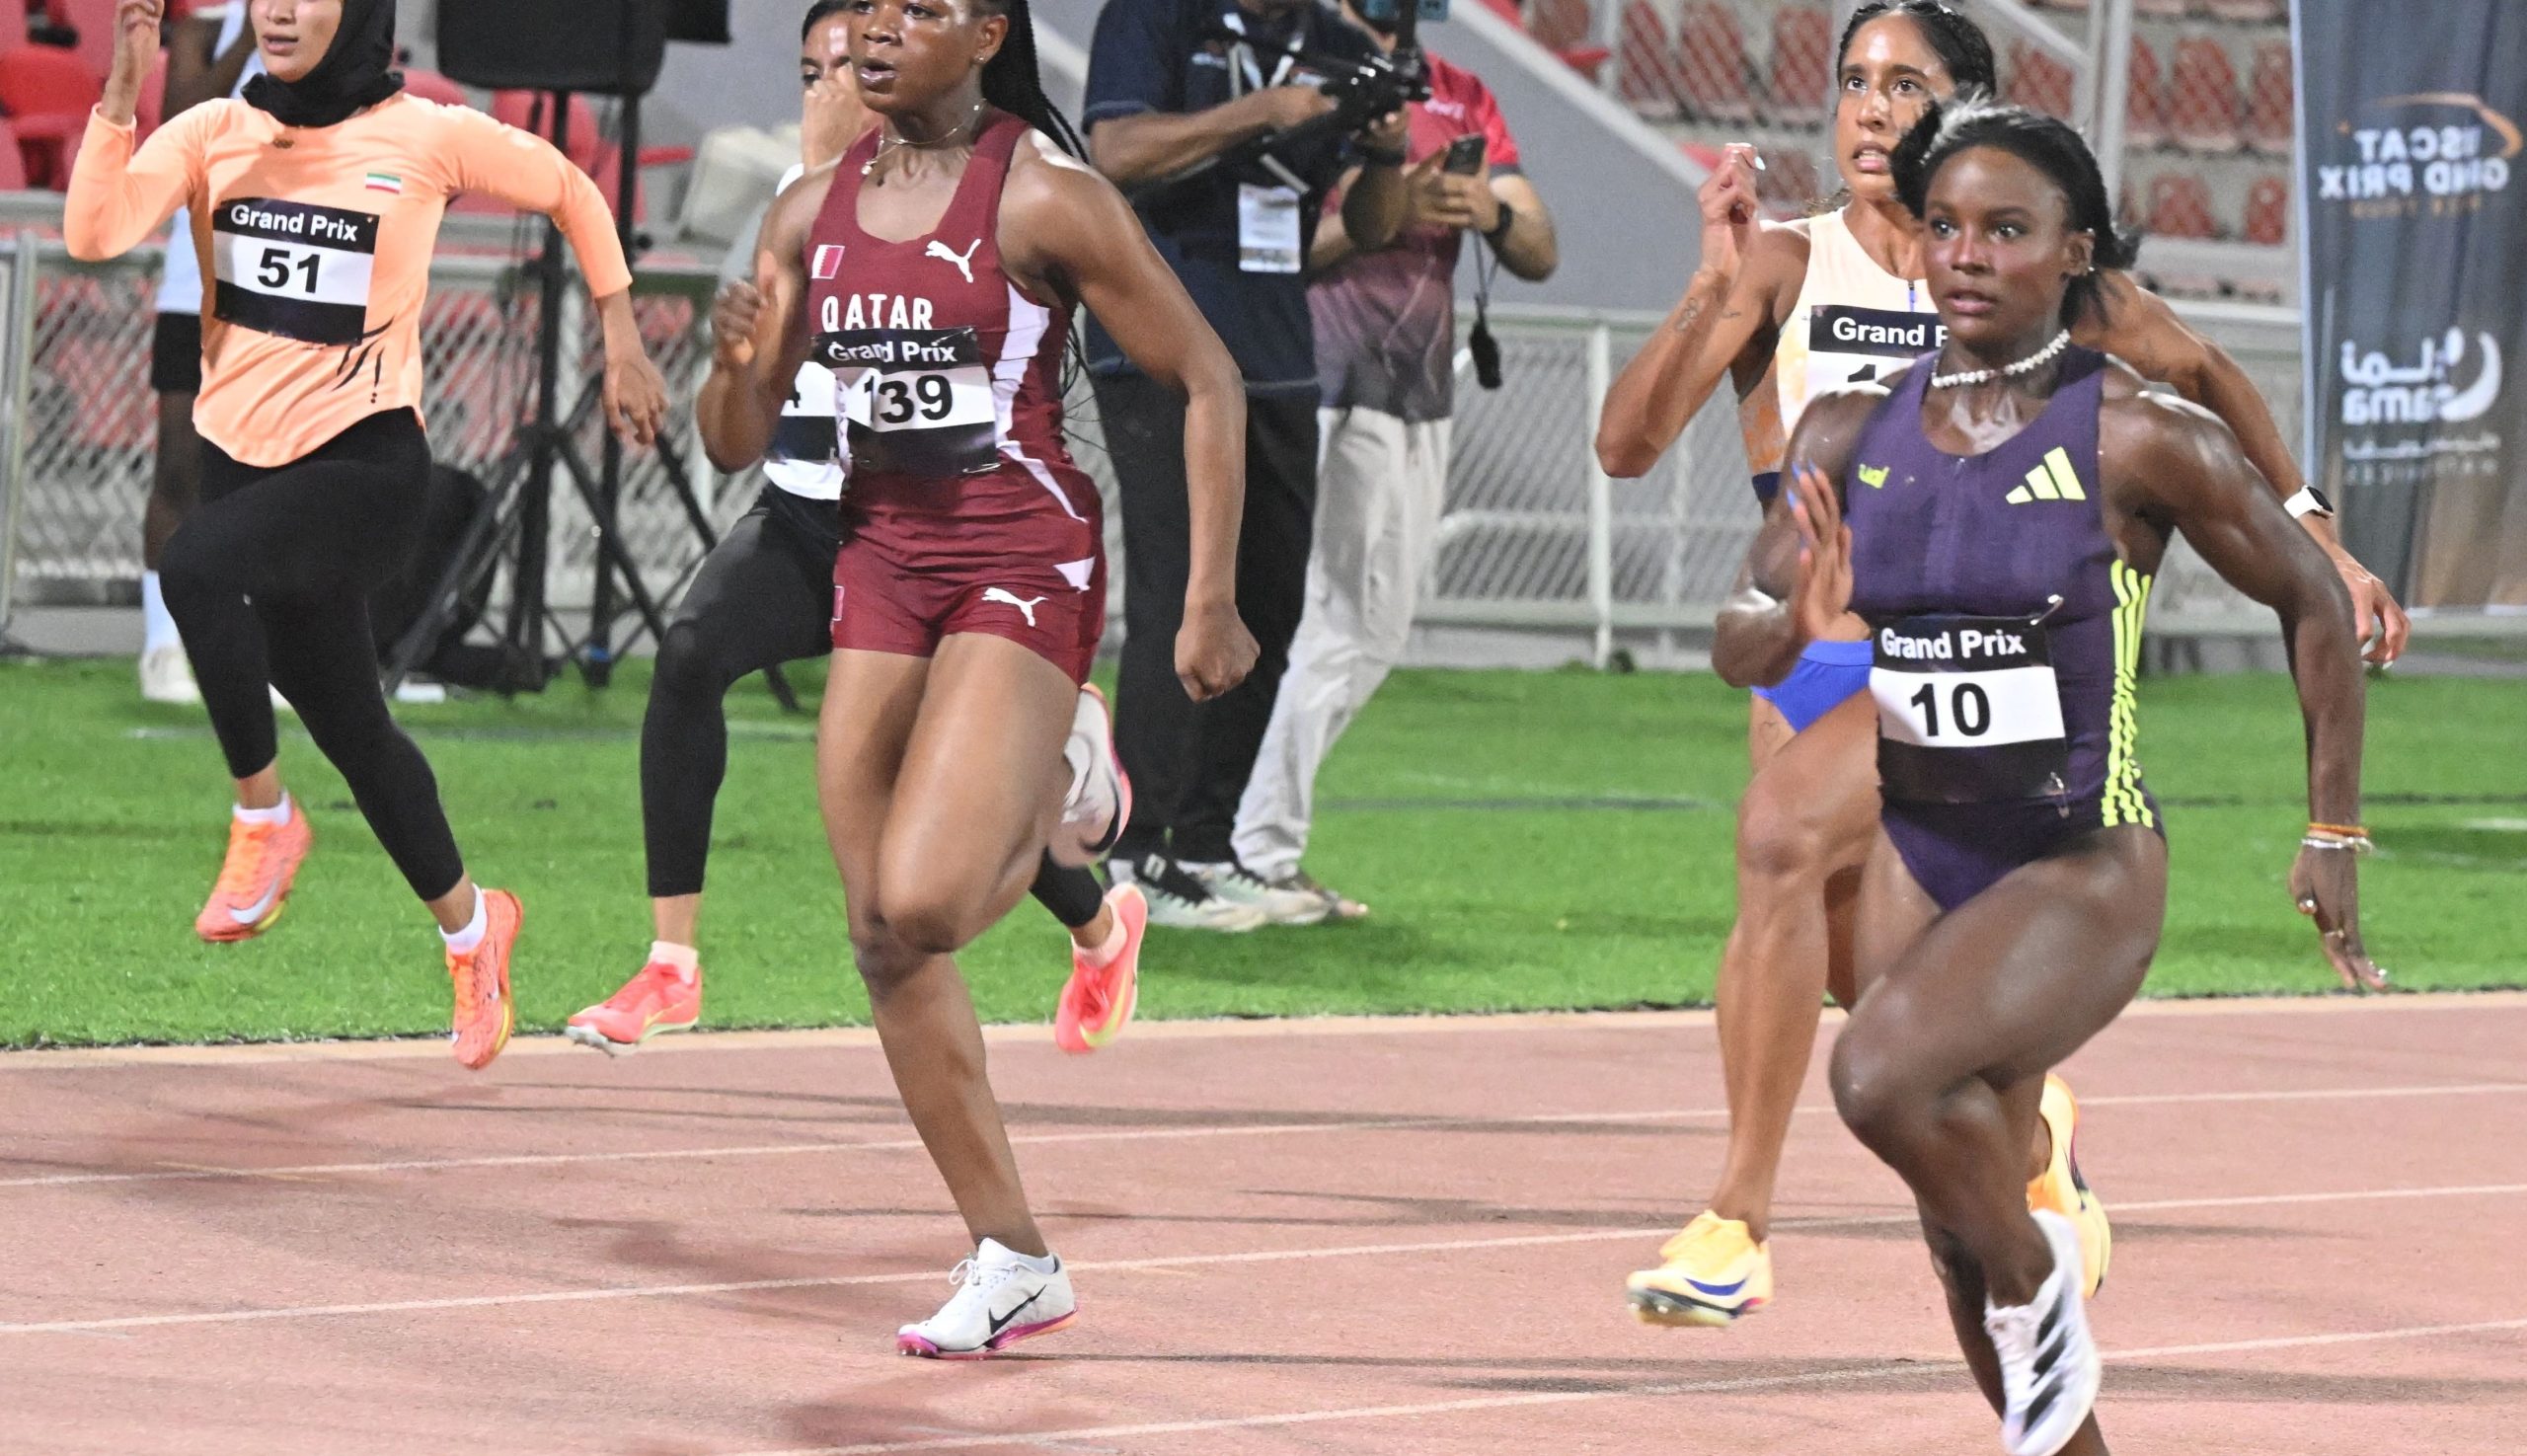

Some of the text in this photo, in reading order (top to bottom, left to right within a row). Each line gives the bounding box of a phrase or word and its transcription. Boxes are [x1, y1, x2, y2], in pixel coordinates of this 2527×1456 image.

[230, 204, 358, 242] Grand Prix
[257, 248, 321, 294] 51
[821, 294, 933, 333] QATAR
[1832, 316, 1925, 346] Grand
[902, 341, 958, 363] Prix
[1880, 628, 2027, 659] Grand Prix
[1910, 682, 1991, 736] 10
